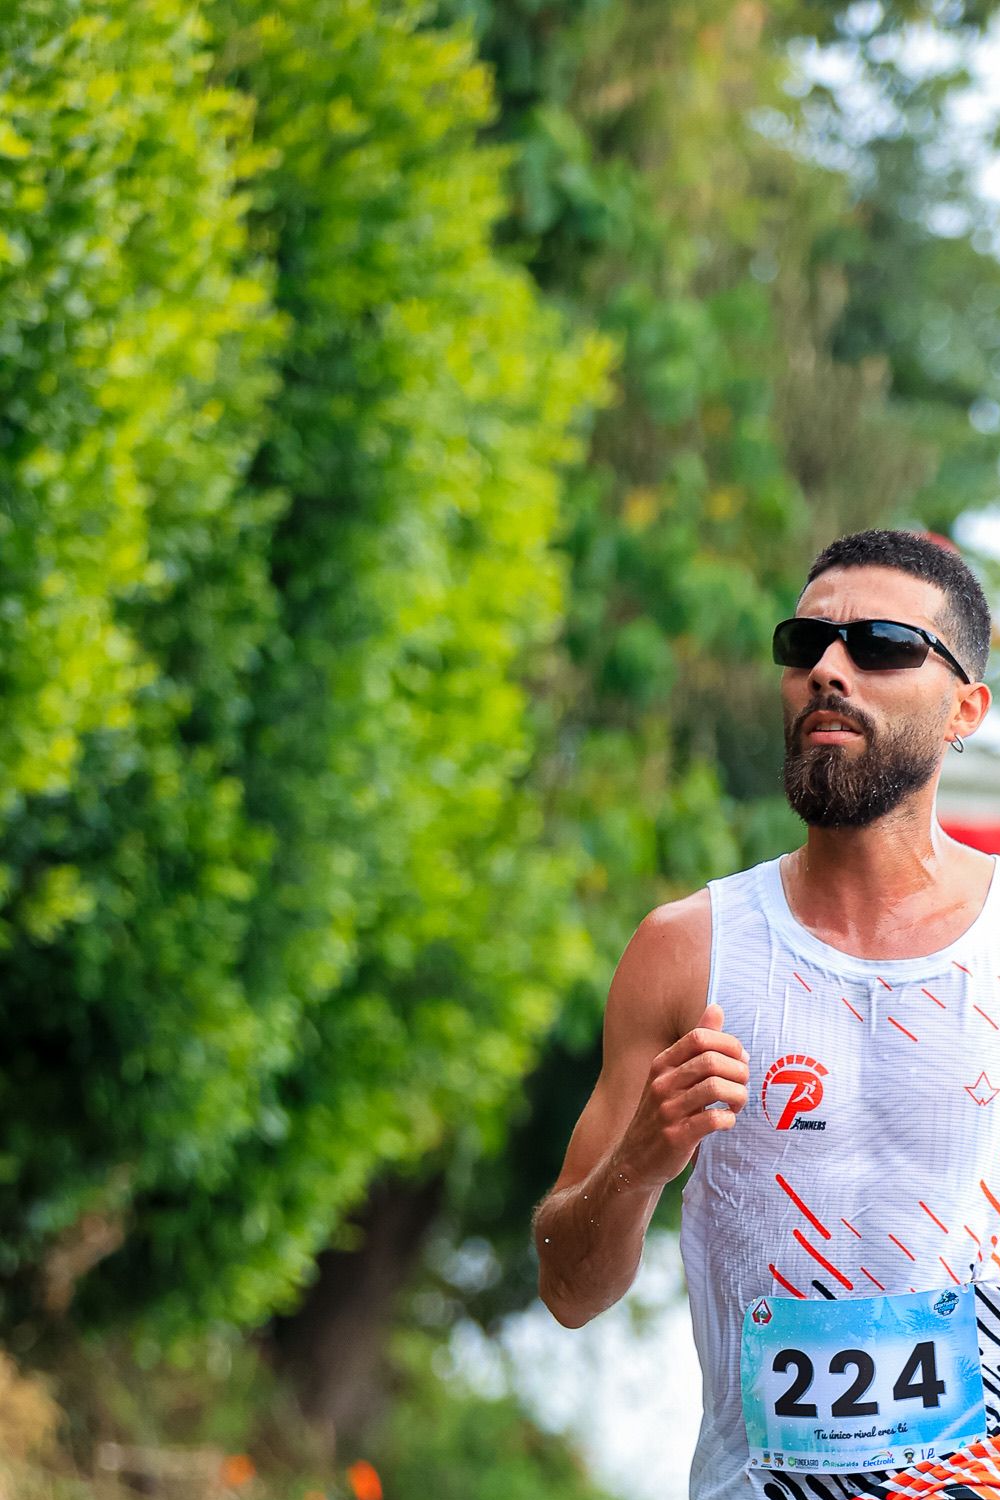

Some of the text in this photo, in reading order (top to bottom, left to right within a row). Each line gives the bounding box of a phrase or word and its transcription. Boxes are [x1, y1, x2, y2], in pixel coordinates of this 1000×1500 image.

[772, 1341, 947, 1418] 224
[814, 1422, 908, 1440] Tu único rival eres tú
[863, 1457, 895, 1467] Electrolit
